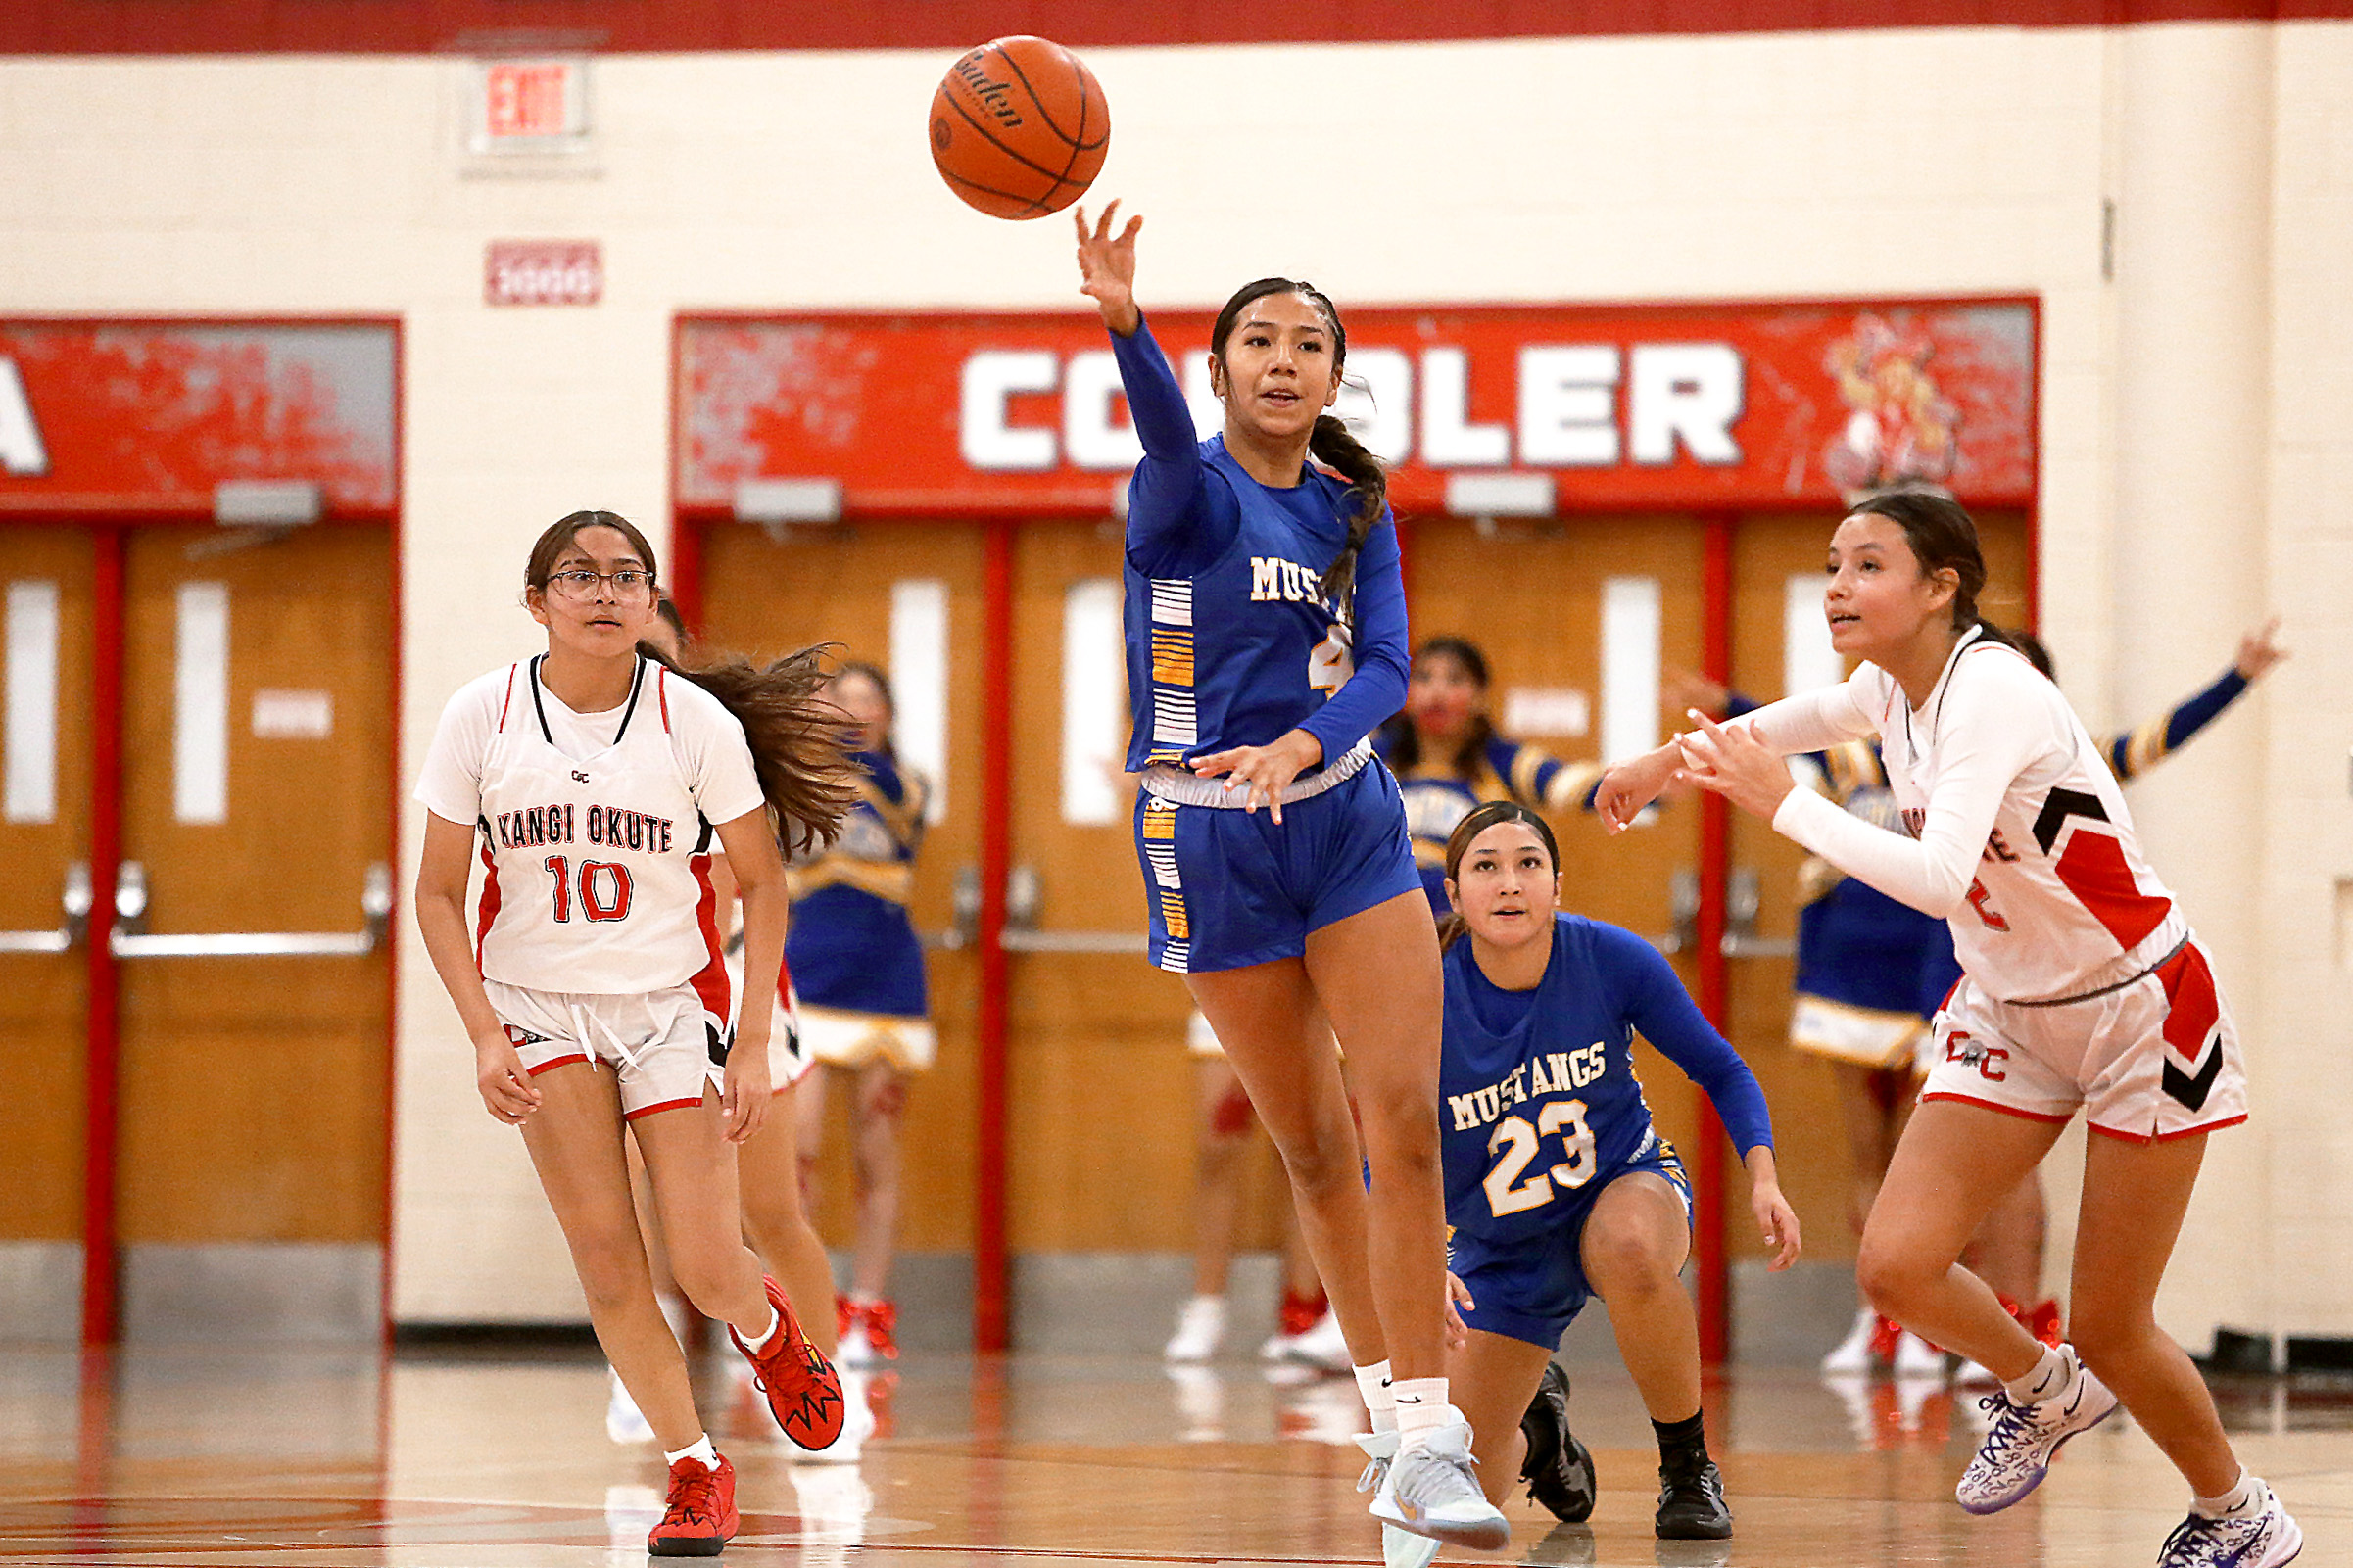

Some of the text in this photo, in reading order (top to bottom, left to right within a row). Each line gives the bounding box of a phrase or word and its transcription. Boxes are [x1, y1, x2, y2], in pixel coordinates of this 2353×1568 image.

[497, 803, 673, 854] KANGI OKUTE
[545, 855, 634, 923] 10
[1447, 1041, 1606, 1131] MUSTANGS
[1482, 1098, 1597, 1217] 23
